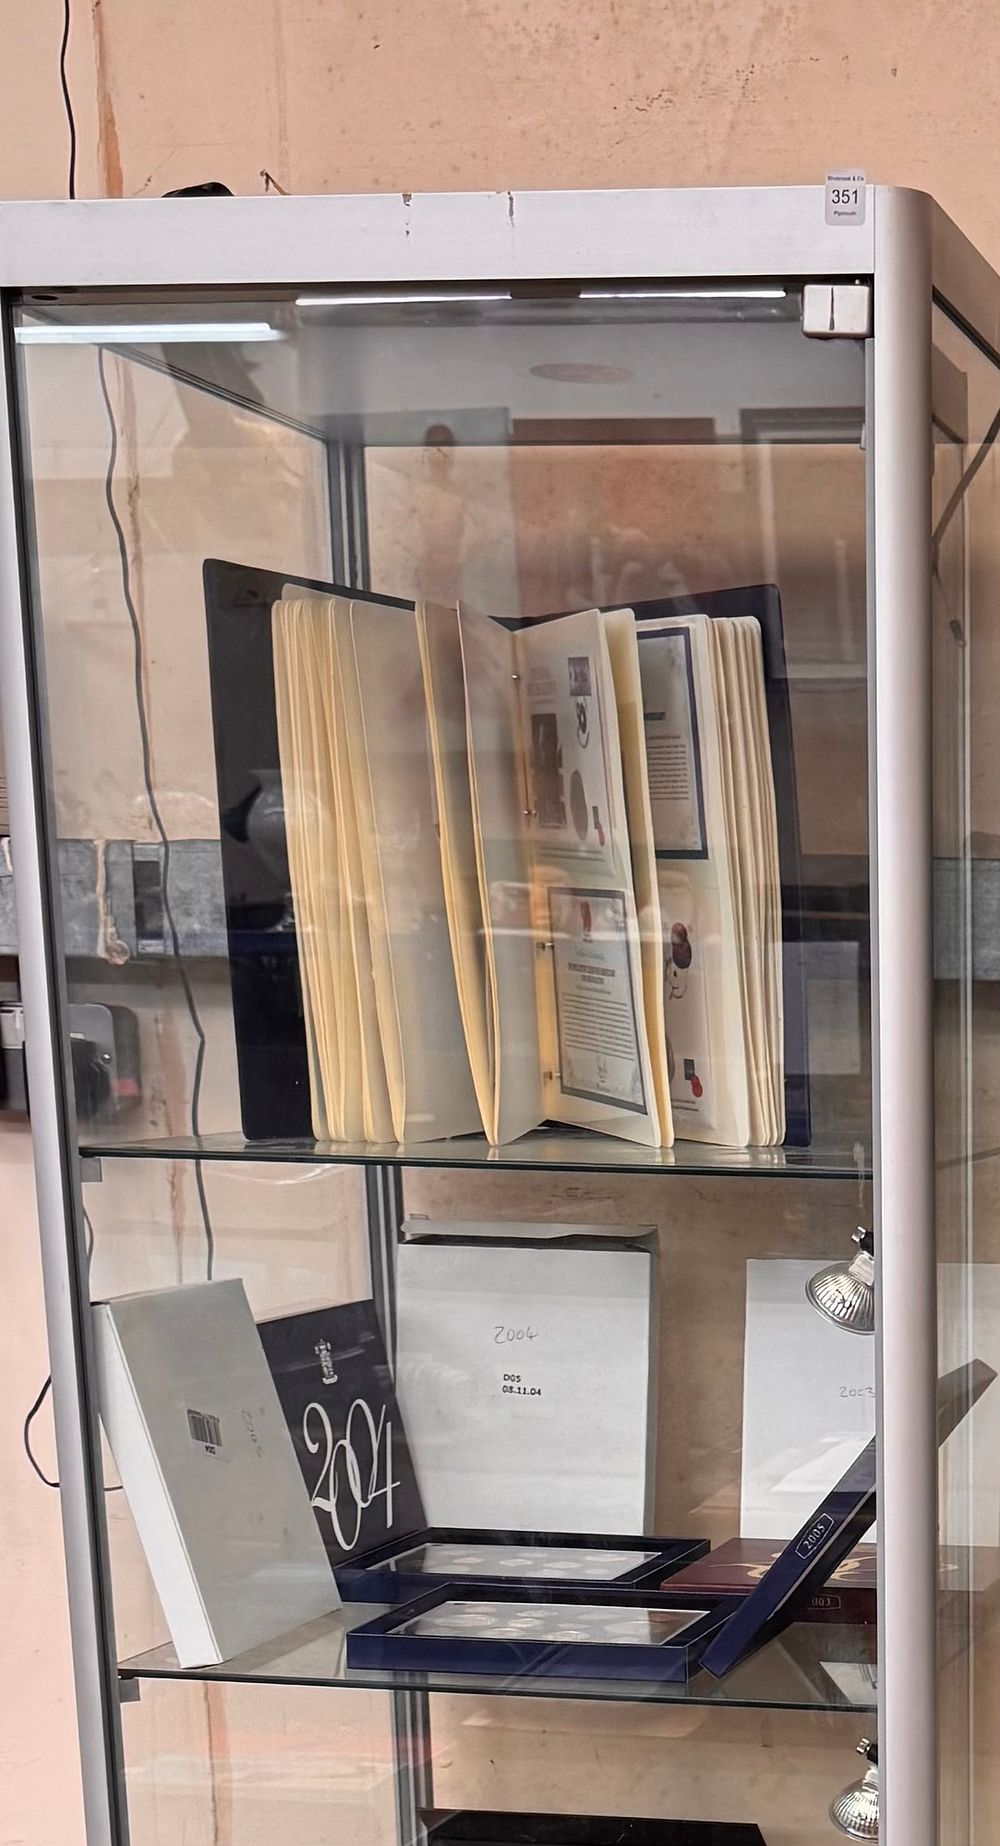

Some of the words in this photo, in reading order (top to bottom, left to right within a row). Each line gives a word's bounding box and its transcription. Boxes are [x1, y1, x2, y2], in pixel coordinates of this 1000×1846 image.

[831, 189, 858, 204] 351
[494, 1326, 538, 1344] 2004
[802, 1523, 826, 1550] 2005
